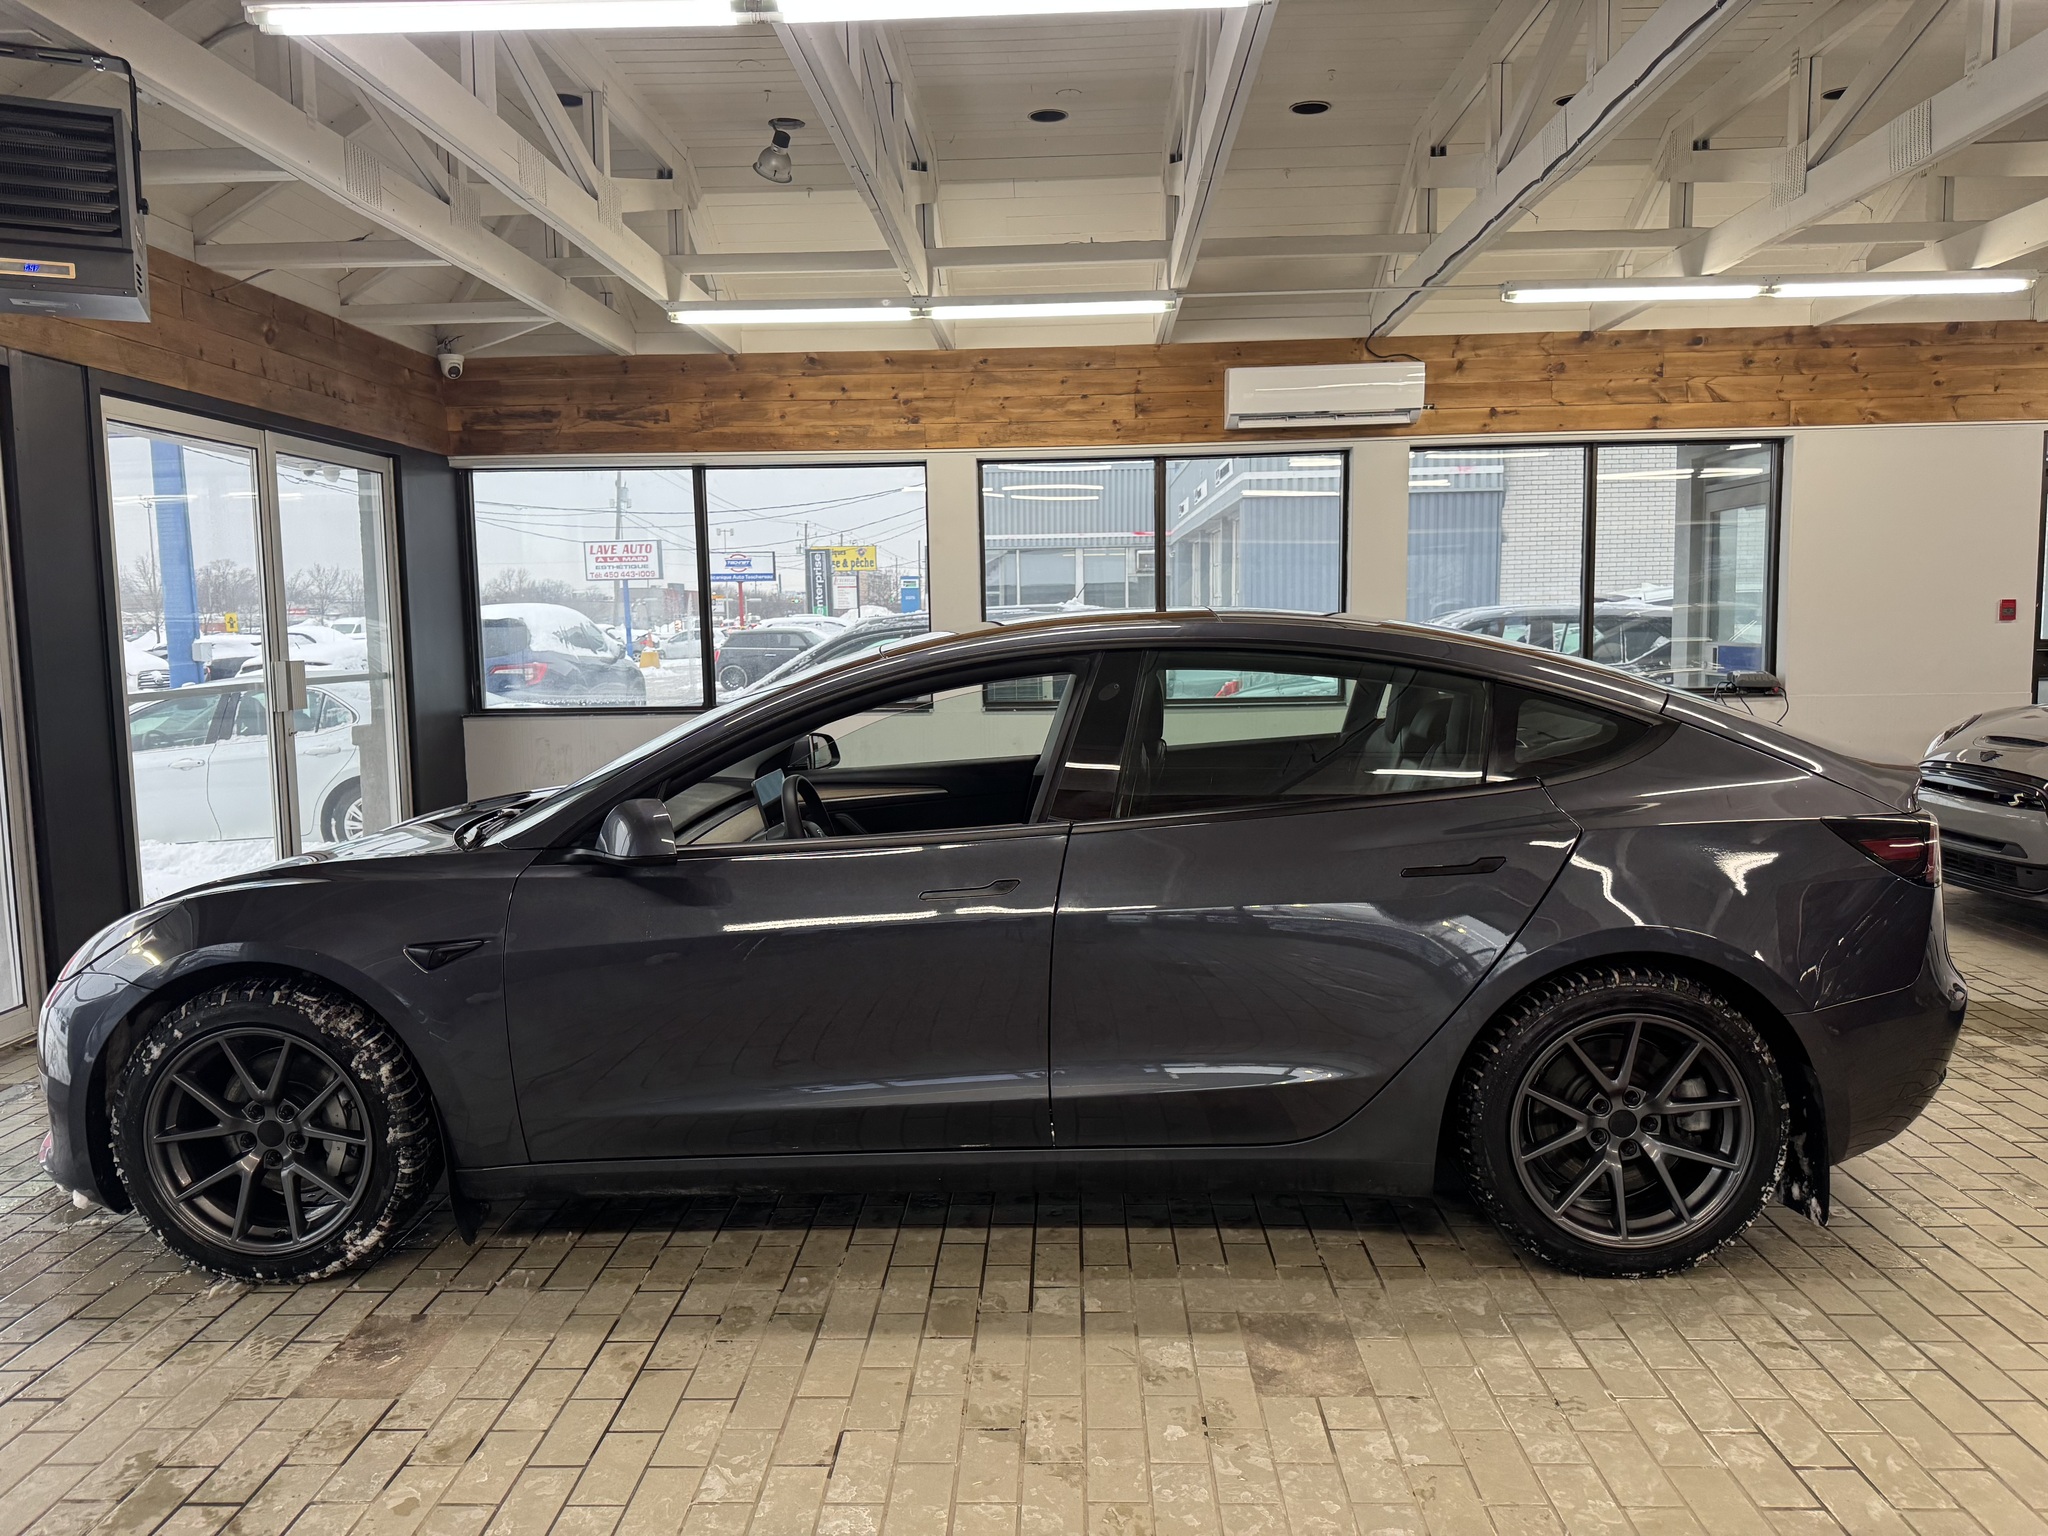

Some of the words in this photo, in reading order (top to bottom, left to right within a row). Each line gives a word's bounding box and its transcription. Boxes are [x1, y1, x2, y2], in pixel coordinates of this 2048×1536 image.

[589, 544, 618, 555] LAVE
[622, 544, 652, 554] AUTO
[850, 557, 874, 570] pêche
[603, 571, 619, 579] 450
[620, 570, 656, 578] 443-1009
